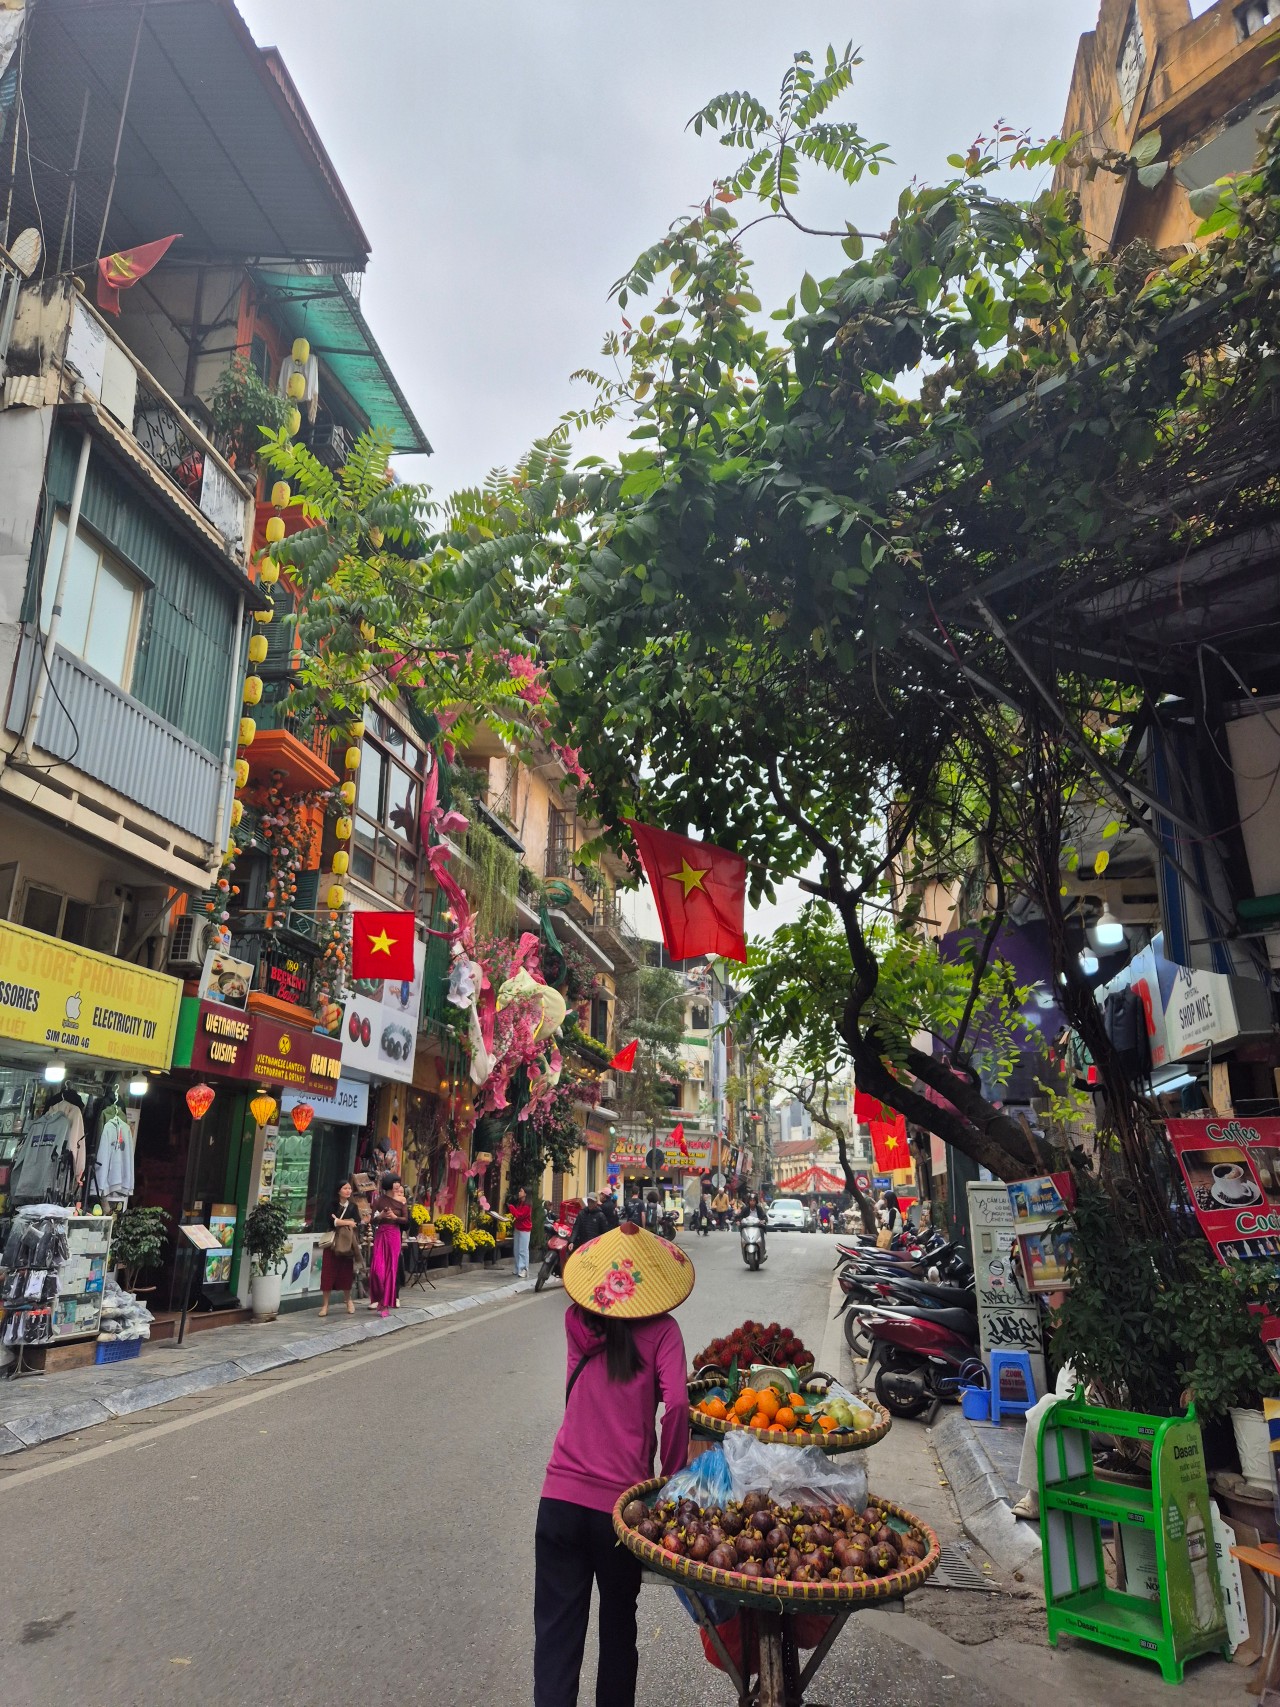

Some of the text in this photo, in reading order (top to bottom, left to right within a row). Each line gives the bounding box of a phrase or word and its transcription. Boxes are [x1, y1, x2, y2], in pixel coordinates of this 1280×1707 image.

[17, 940, 77, 986] STORE
[79, 961, 135, 1001] PHONG
[92, 1006, 157, 1040] ELECTRICITY TOY
[1179, 1002, 1195, 1029] SHOP
[1195, 994, 1213, 1022] NICE
[46, 1029, 90, 1048] SIM CARD 4G
[206, 1013, 249, 1041] VIETNAMESE
[210, 1041, 237, 1064] CUISINE
[256, 1054, 306, 1074] VIETNAMESE LANTERN
[254, 1065, 284, 1079] RESTAURANT
[289, 1072, 306, 1084] DRINKS
[338, 1092, 358, 1108] JADE
[1206, 1121, 1261, 1147] Coffee
[1173, 1442, 1199, 1460] Dasani
